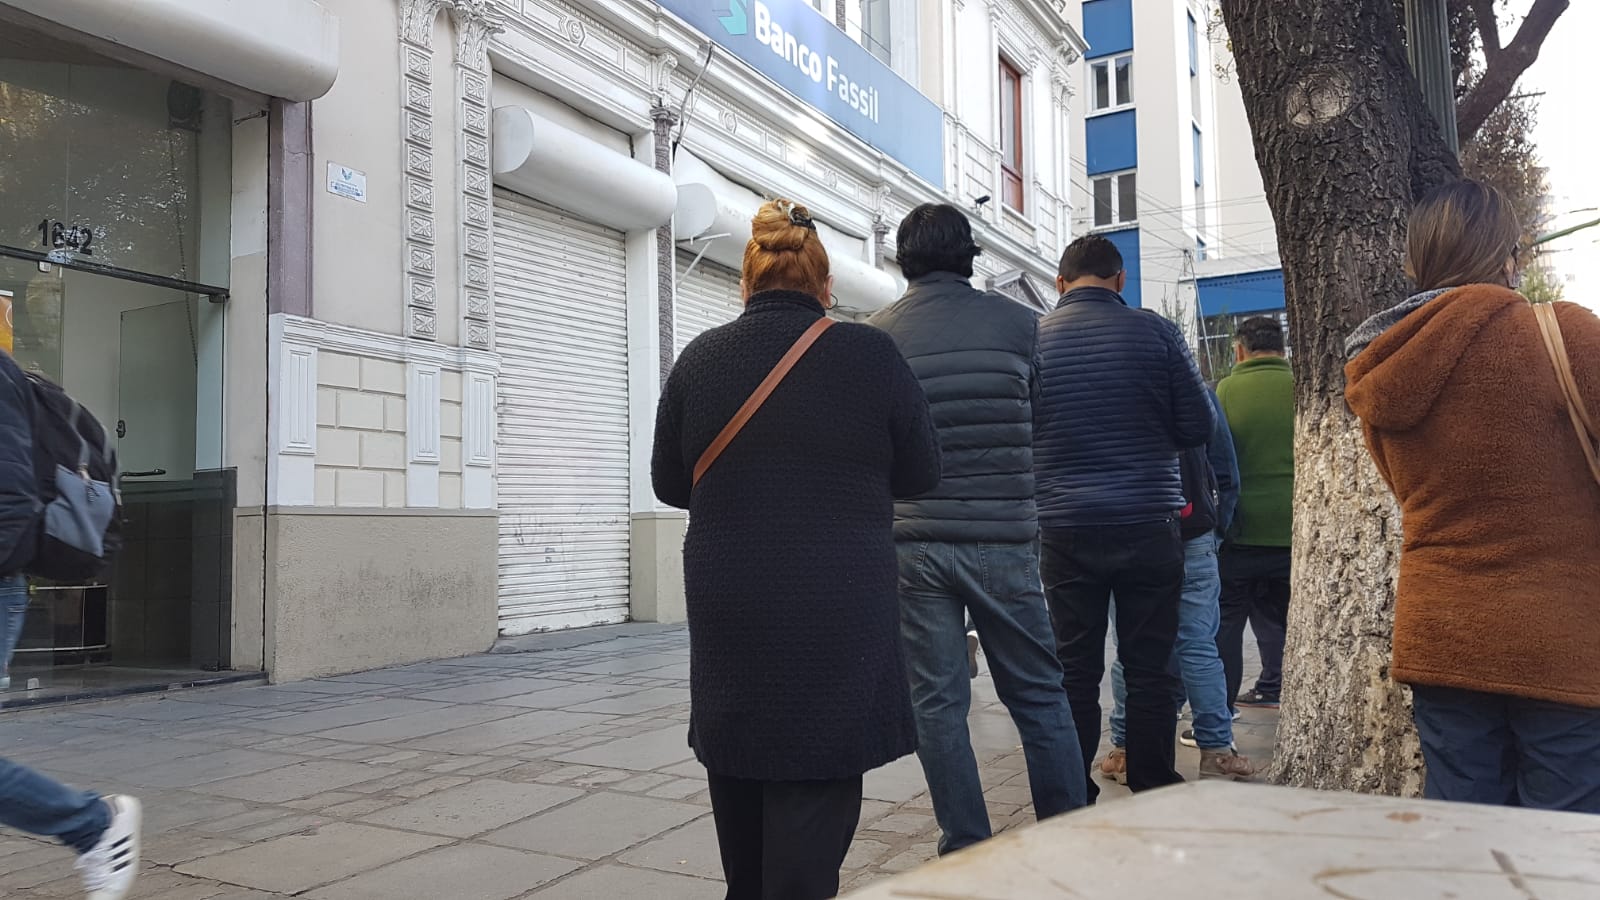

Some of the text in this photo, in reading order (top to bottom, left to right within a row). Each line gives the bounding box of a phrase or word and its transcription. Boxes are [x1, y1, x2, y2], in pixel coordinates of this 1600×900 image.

[754, 1, 878, 123] Banco Fassil
[38, 219, 92, 255] 1642
